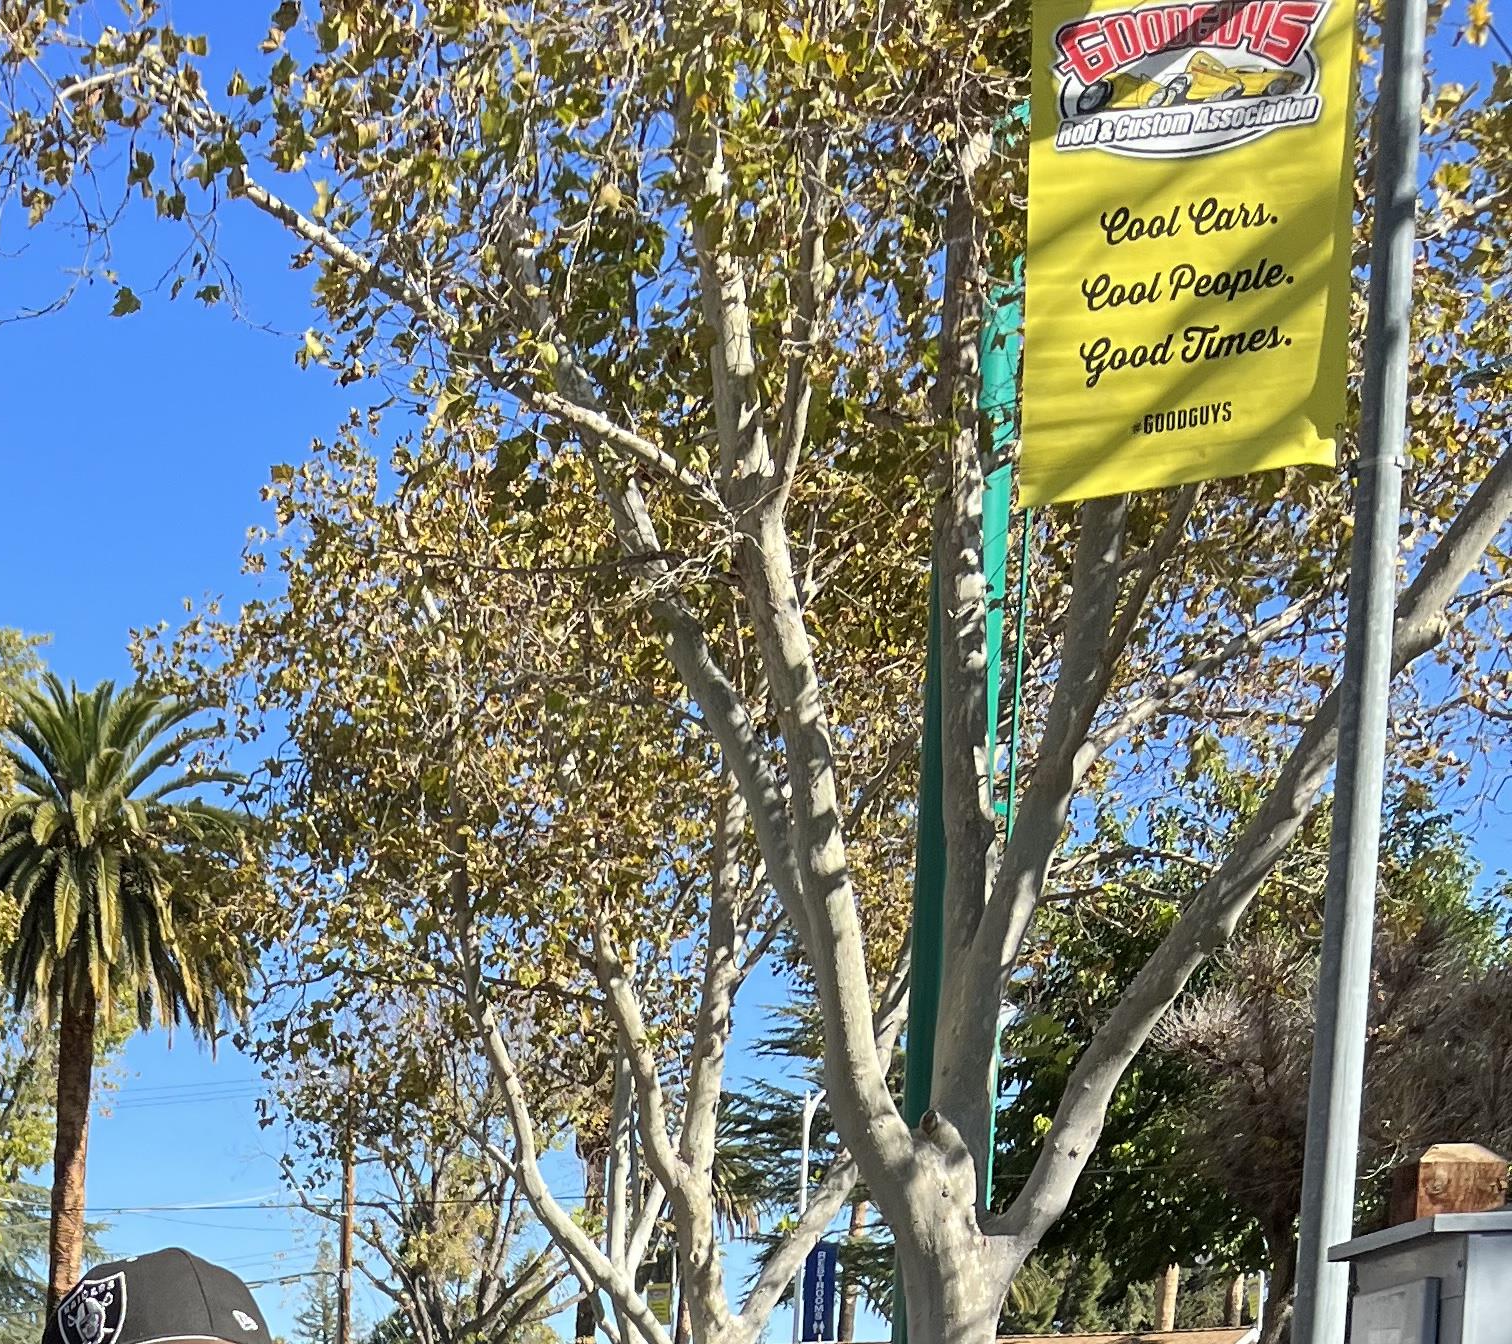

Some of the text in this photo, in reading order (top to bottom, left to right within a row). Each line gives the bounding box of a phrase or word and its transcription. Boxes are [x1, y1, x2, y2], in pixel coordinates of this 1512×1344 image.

[1059, 0, 1320, 86] GOODGUYS
[1193, 97, 1319, 134] Association
[1100, 197, 1278, 245] Cool Cars.
[1081, 258, 1294, 311] Cool People.
[1080, 324, 1292, 388] Good Times.
[1131, 401, 1232, 435] #GOODGUYS
